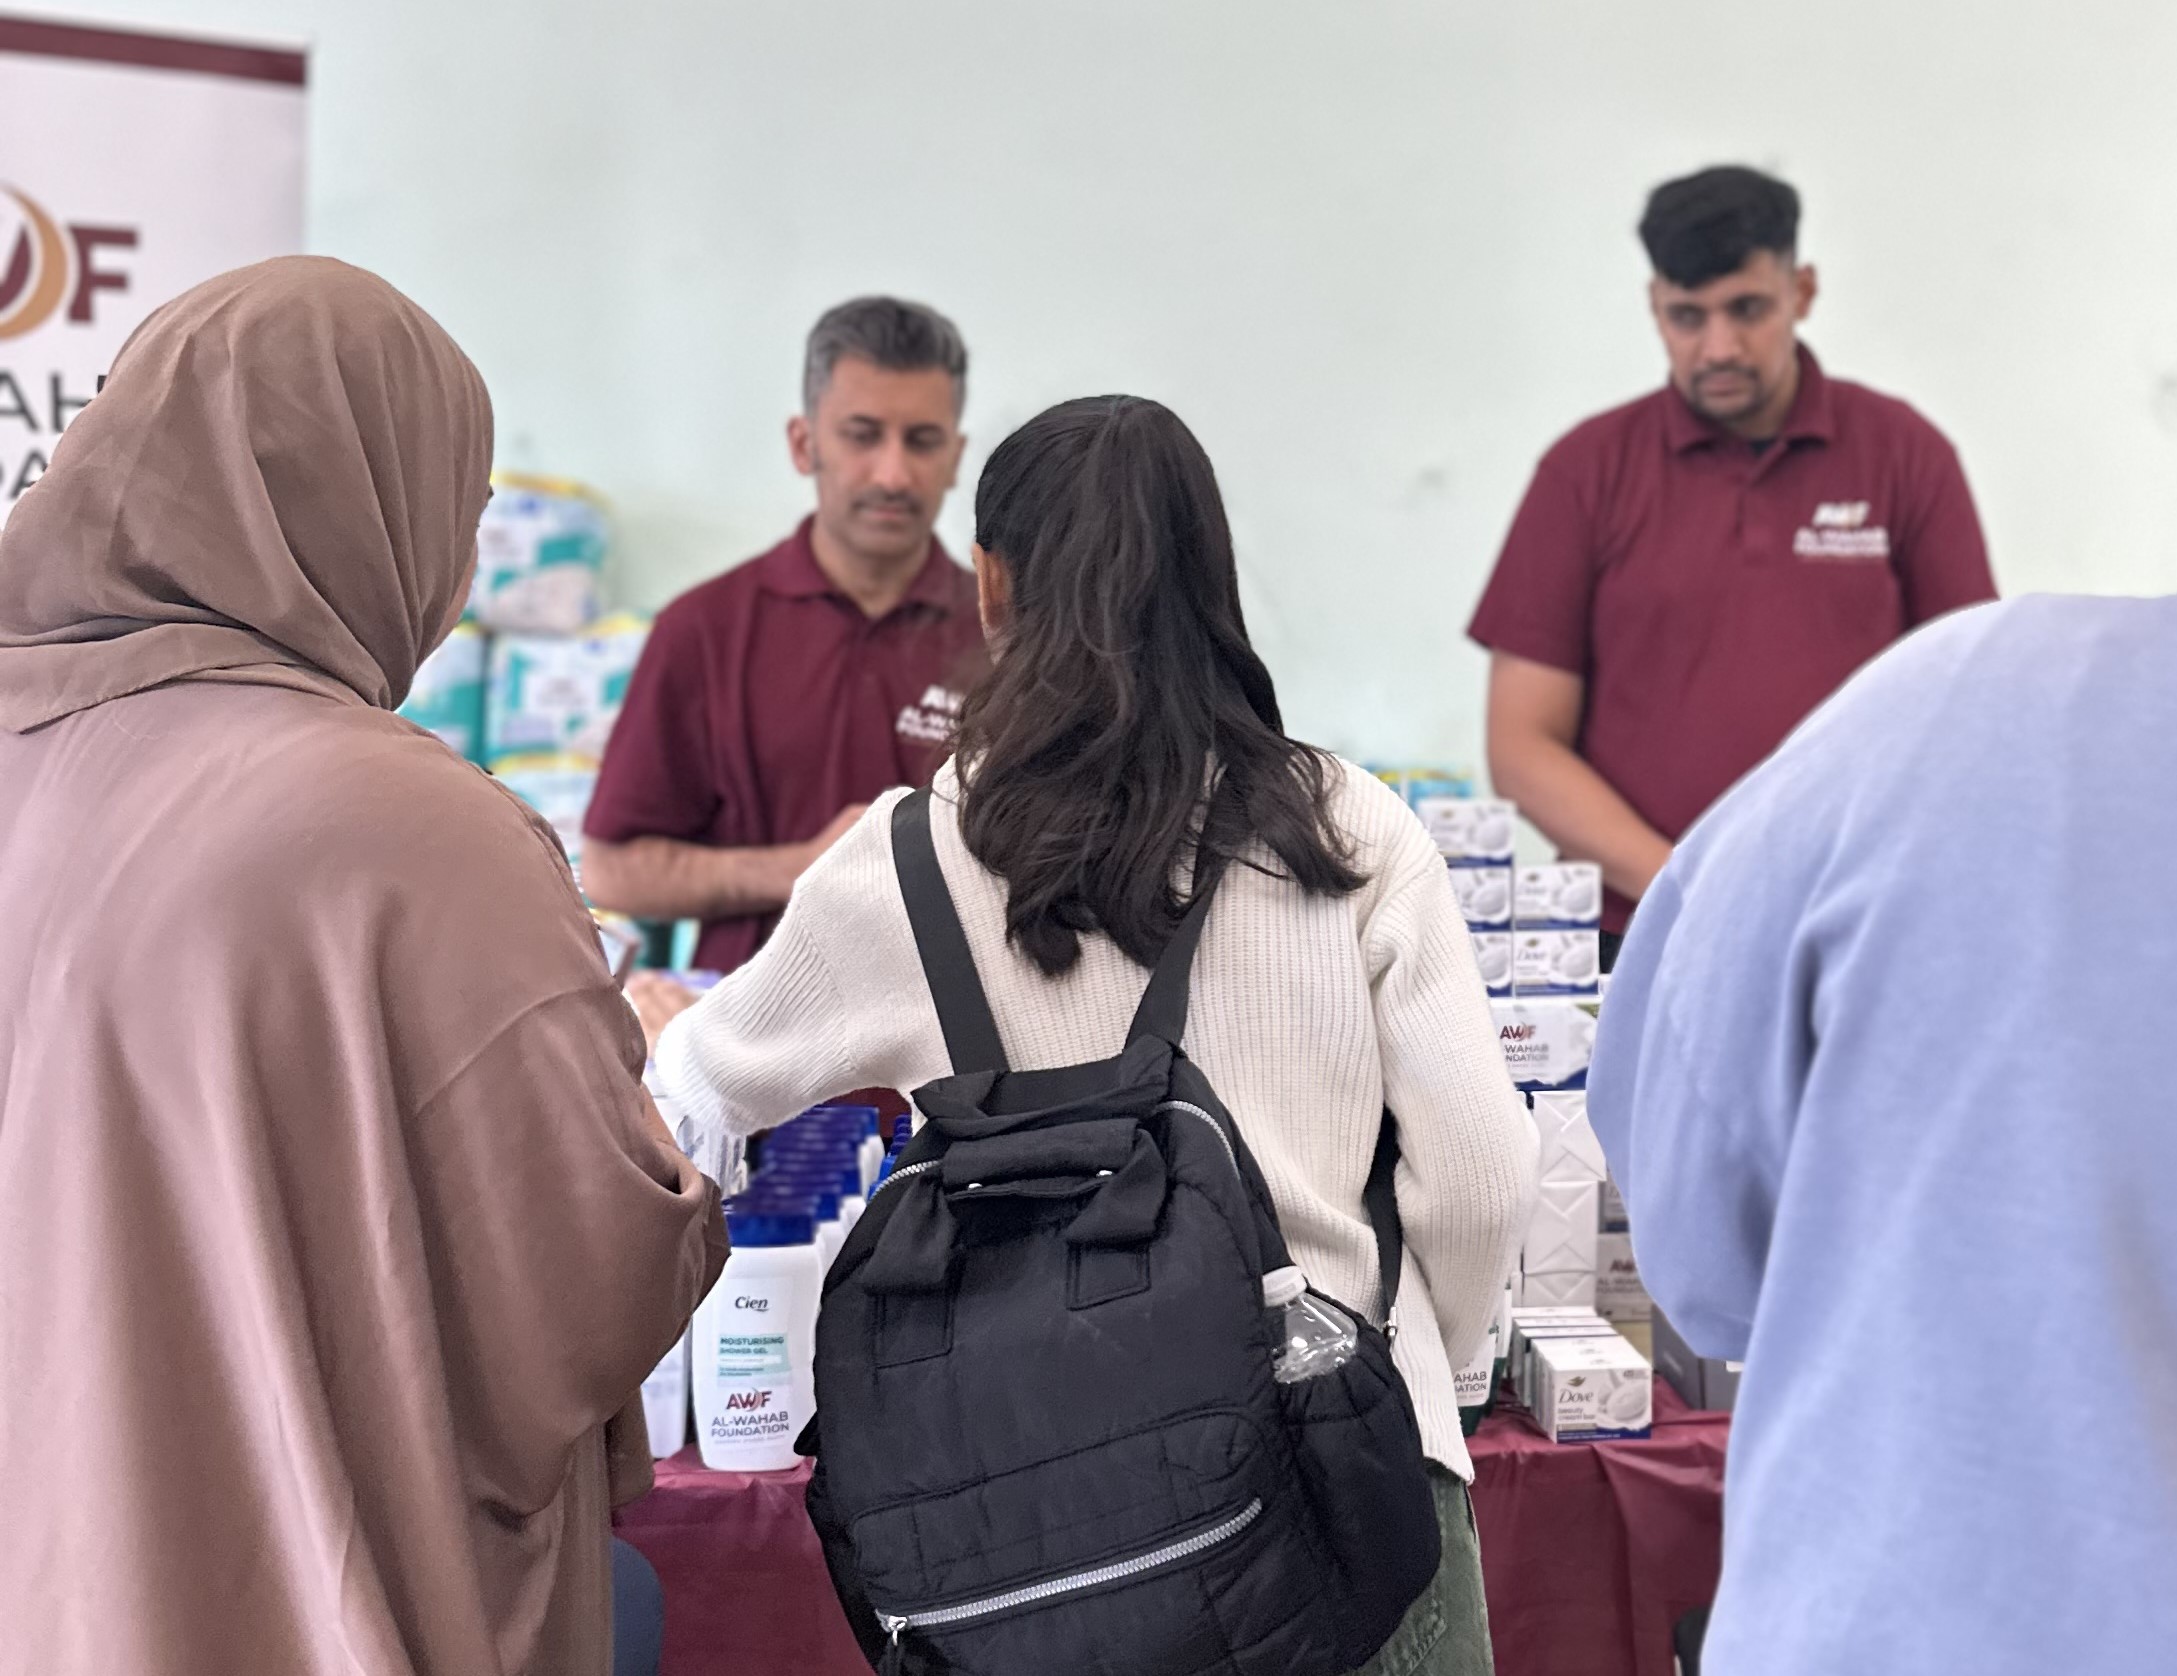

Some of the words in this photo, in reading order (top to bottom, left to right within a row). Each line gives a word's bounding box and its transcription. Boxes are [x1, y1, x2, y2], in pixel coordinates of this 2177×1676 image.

[734, 1295, 770, 1312] Cien
[720, 1335, 785, 1346] MOISTURISING
[725, 1390, 773, 1411] AWF
[1558, 1388, 1594, 1403] Dove
[711, 1411, 789, 1427] AL-WAHAB
[710, 1422, 790, 1437] FOUNDATION
